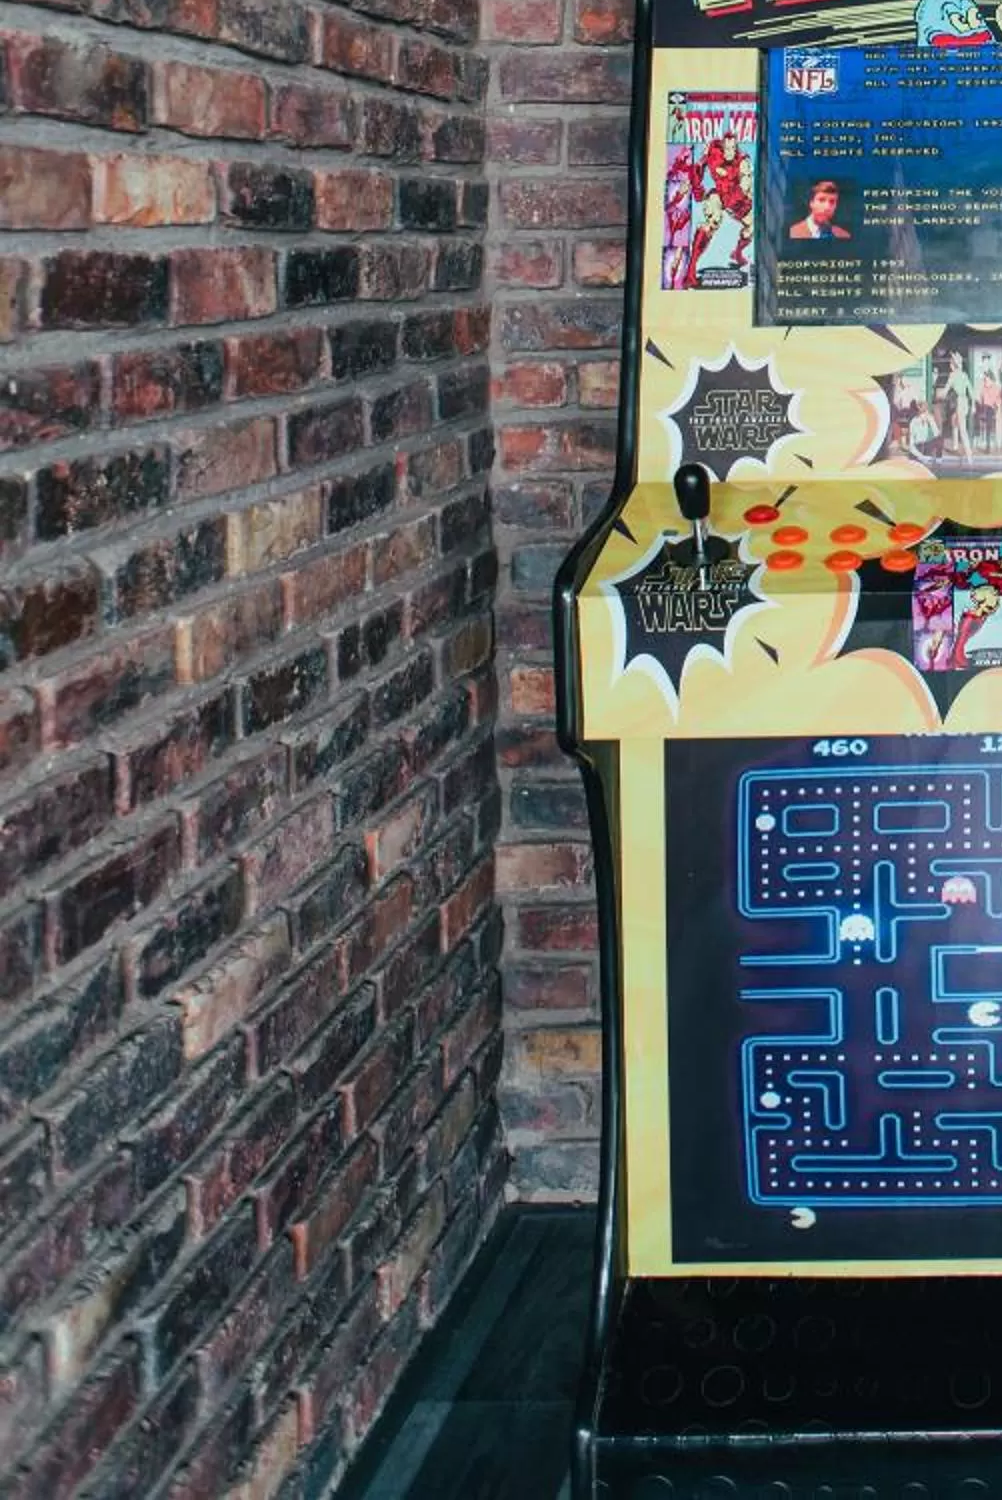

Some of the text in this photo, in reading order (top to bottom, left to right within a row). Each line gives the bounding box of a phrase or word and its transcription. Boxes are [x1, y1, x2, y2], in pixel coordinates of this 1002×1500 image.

[787, 69, 833, 92] NFL
[685, 111, 757, 143] IRON MA
[950, 188, 973, 198] THE
[776, 273, 863, 283] INCREDIBLE
[776, 288, 803, 298] ALL
[776, 307, 828, 317] INSERT
[694, 389, 783, 416] STAR
[694, 423, 783, 451] WARS
[944, 548, 998, 563] IRON
[637, 591, 739, 632] WARS
[813, 738, 868, 757] 460
